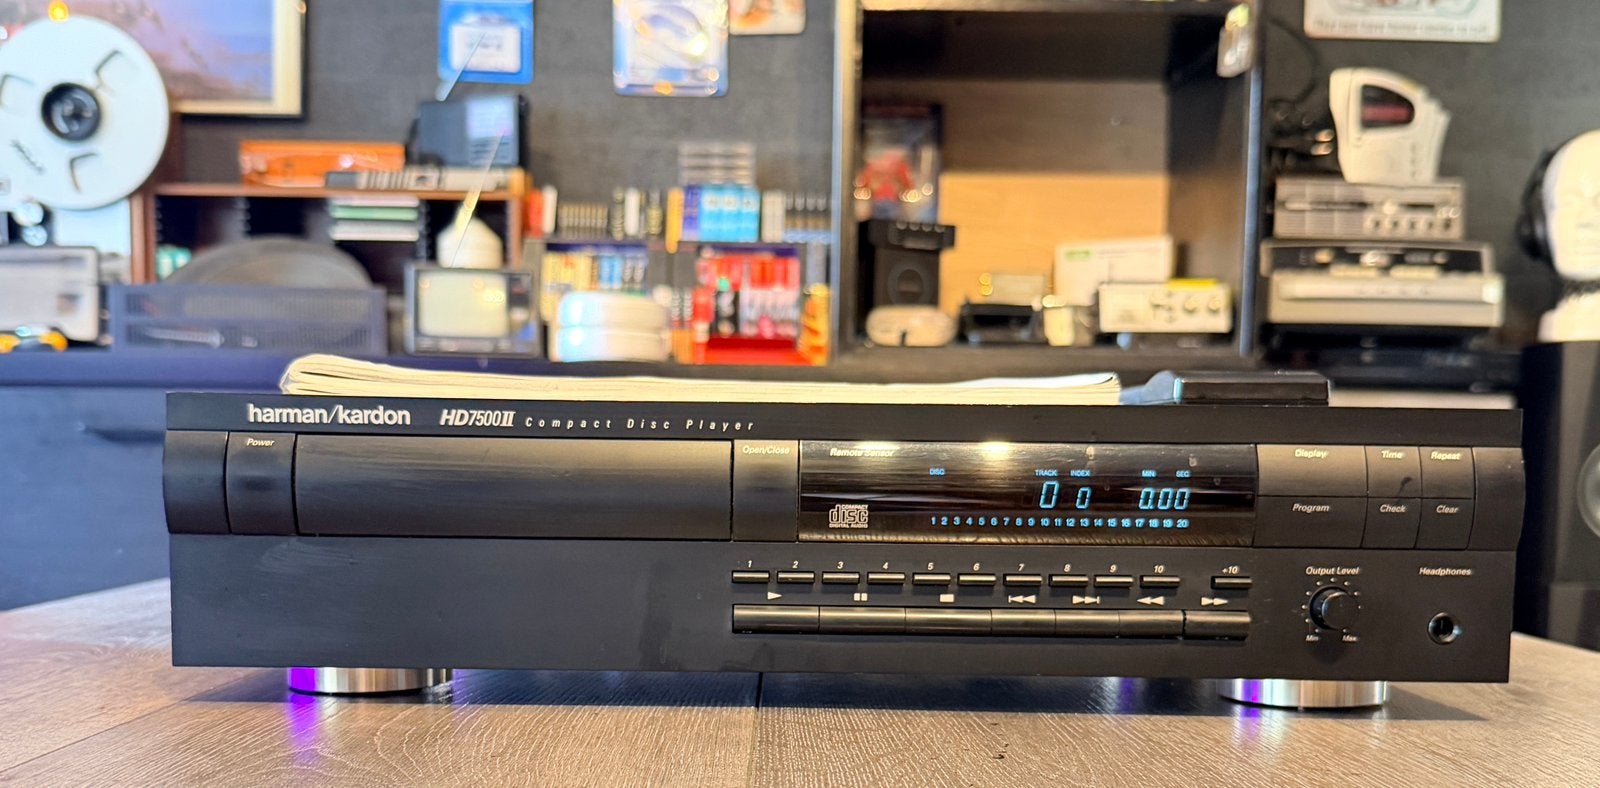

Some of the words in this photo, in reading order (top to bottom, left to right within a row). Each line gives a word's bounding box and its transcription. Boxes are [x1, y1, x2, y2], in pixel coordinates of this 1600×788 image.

[247, 403, 411, 425] harman/kardon
[525, 416, 611, 430] Compact
[626, 418, 670, 430] Disc
[685, 419, 754, 432] Player
[246, 437, 275, 447] Power
[742, 444, 790, 455] Open/Close
[829, 447, 863, 457] Remote
[864, 447, 895, 457] Sensor
[1295, 449, 1328, 459] Display
[1381, 450, 1403, 459] Time
[1430, 450, 1462, 461] Repeat
[1034, 469, 1058, 477] TRACK
[1070, 469, 1091, 477] INDEX
[1141, 469, 1157, 478] MIN
[1175, 470, 1190, 478] SEC
[1039, 480, 1060, 509] 0
[1075, 487, 1091, 509] 0
[1292, 503, 1330, 514] Program
[1379, 504, 1406, 513] Check
[1436, 504, 1459, 514] Clear
[828, 504, 869, 524] disc
[931, 516, 936, 525] 1
[941, 516, 948, 526] 2
[953, 516, 961, 526] 3
[966, 517, 973, 525] 4
[978, 516, 986, 526] 5
[990, 517, 998, 526] 6
[1003, 516, 1010, 526] 7
[1015, 517, 1023, 526] 8
[1027, 517, 1036, 527] 9
[1040, 517, 1050, 527] 10
[1054, 518, 1062, 527] 11
[1065, 518, 1076, 527] 12
[1079, 517, 1090, 527] 13
[1093, 518, 1104, 527] 14
[1107, 518, 1117, 528] 15
[1121, 518, 1131, 528] 16
[1134, 518, 1145, 528] 17
[1148, 518, 1160, 528] 18
[1162, 518, 1174, 528] 19
[1176, 518, 1189, 528] 20
[748, 559, 753, 568] 1
[792, 560, 799, 569] 2
[837, 561, 844, 570] 3
[882, 562, 889, 570] 4
[927, 562, 934, 571] 5
[973, 562, 980, 571] 6
[1018, 563, 1025, 572] 7
[1063, 563, 1071, 573] 8
[1109, 564, 1117, 573] 9
[1154, 565, 1165, 574] 10
[1222, 565, 1239, 575] +10
[1305, 566, 1335, 576] Output
[1336, 566, 1360, 575] Level
[1419, 567, 1472, 577] Headphones
[1305, 634, 1319, 642] Min
[1342, 634, 1357, 642] Max
